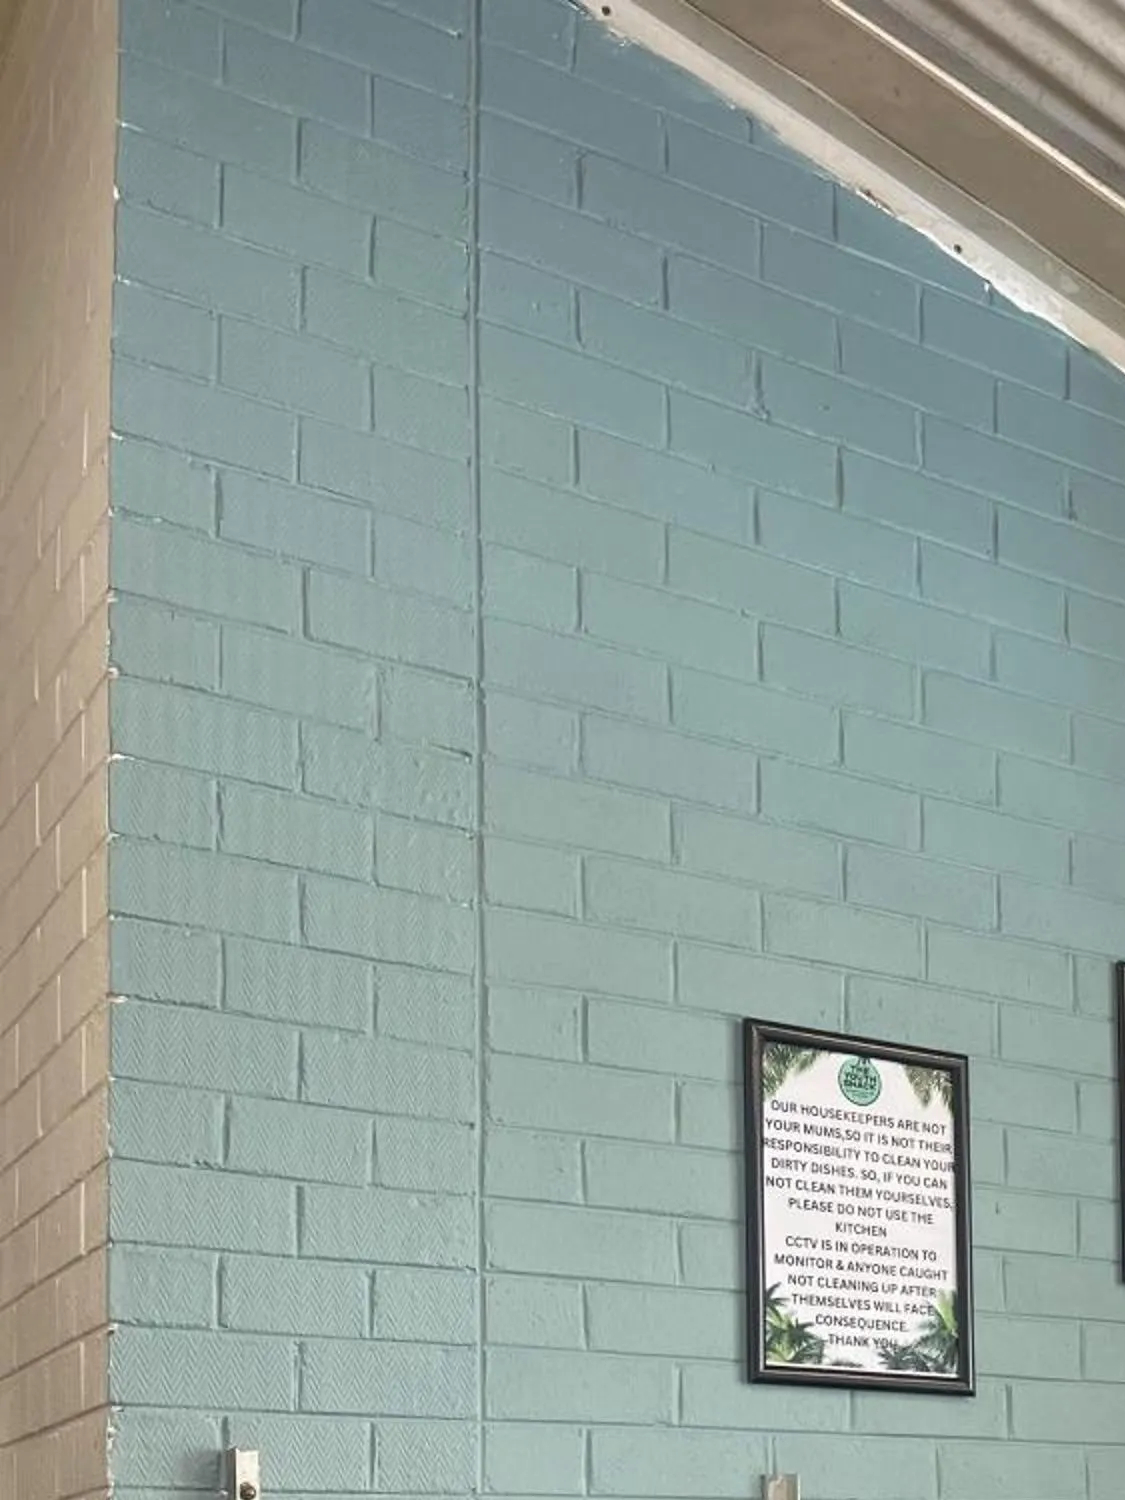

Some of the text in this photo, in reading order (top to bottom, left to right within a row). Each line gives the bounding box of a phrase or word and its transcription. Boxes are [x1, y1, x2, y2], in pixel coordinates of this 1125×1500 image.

[771, 1099, 947, 1136] OUR HOUSEKEEPERS ARE NOT
[765, 1118, 801, 1132] YOUR
[863, 1132, 874, 1144] IT
[877, 1134, 889, 1146] IS
[891, 1136, 915, 1149] NOT
[918, 1137, 953, 1154] THEIR
[764, 1137, 955, 1174] RESPONSIBILITY TO CLEAN YOUR
[771, 1157, 808, 1173] DIRTY
[883, 1171, 893, 1183] IF
[896, 1173, 920, 1187] YOU
[923, 1177, 947, 1190] CAN
[766, 1176, 792, 1189] NOT
[795, 1179, 835, 1195] CLEAN
[839, 1185, 873, 1200] THEM
[788, 1197, 934, 1225] PLEASE DO NOT USE THE
[835, 1222, 887, 1237] KITCHEN
[785, 1235, 937, 1262] CCTV IS IN OPERATION TO
[773, 1253, 948, 1281] MONITOR & ANYONE CAUGHT
[787, 1274, 937, 1299] NOT CLEANING UP AFTER
[792, 1293, 935, 1317] THEMSELVES WILL FACE
[827, 1333, 868, 1348] THANK
